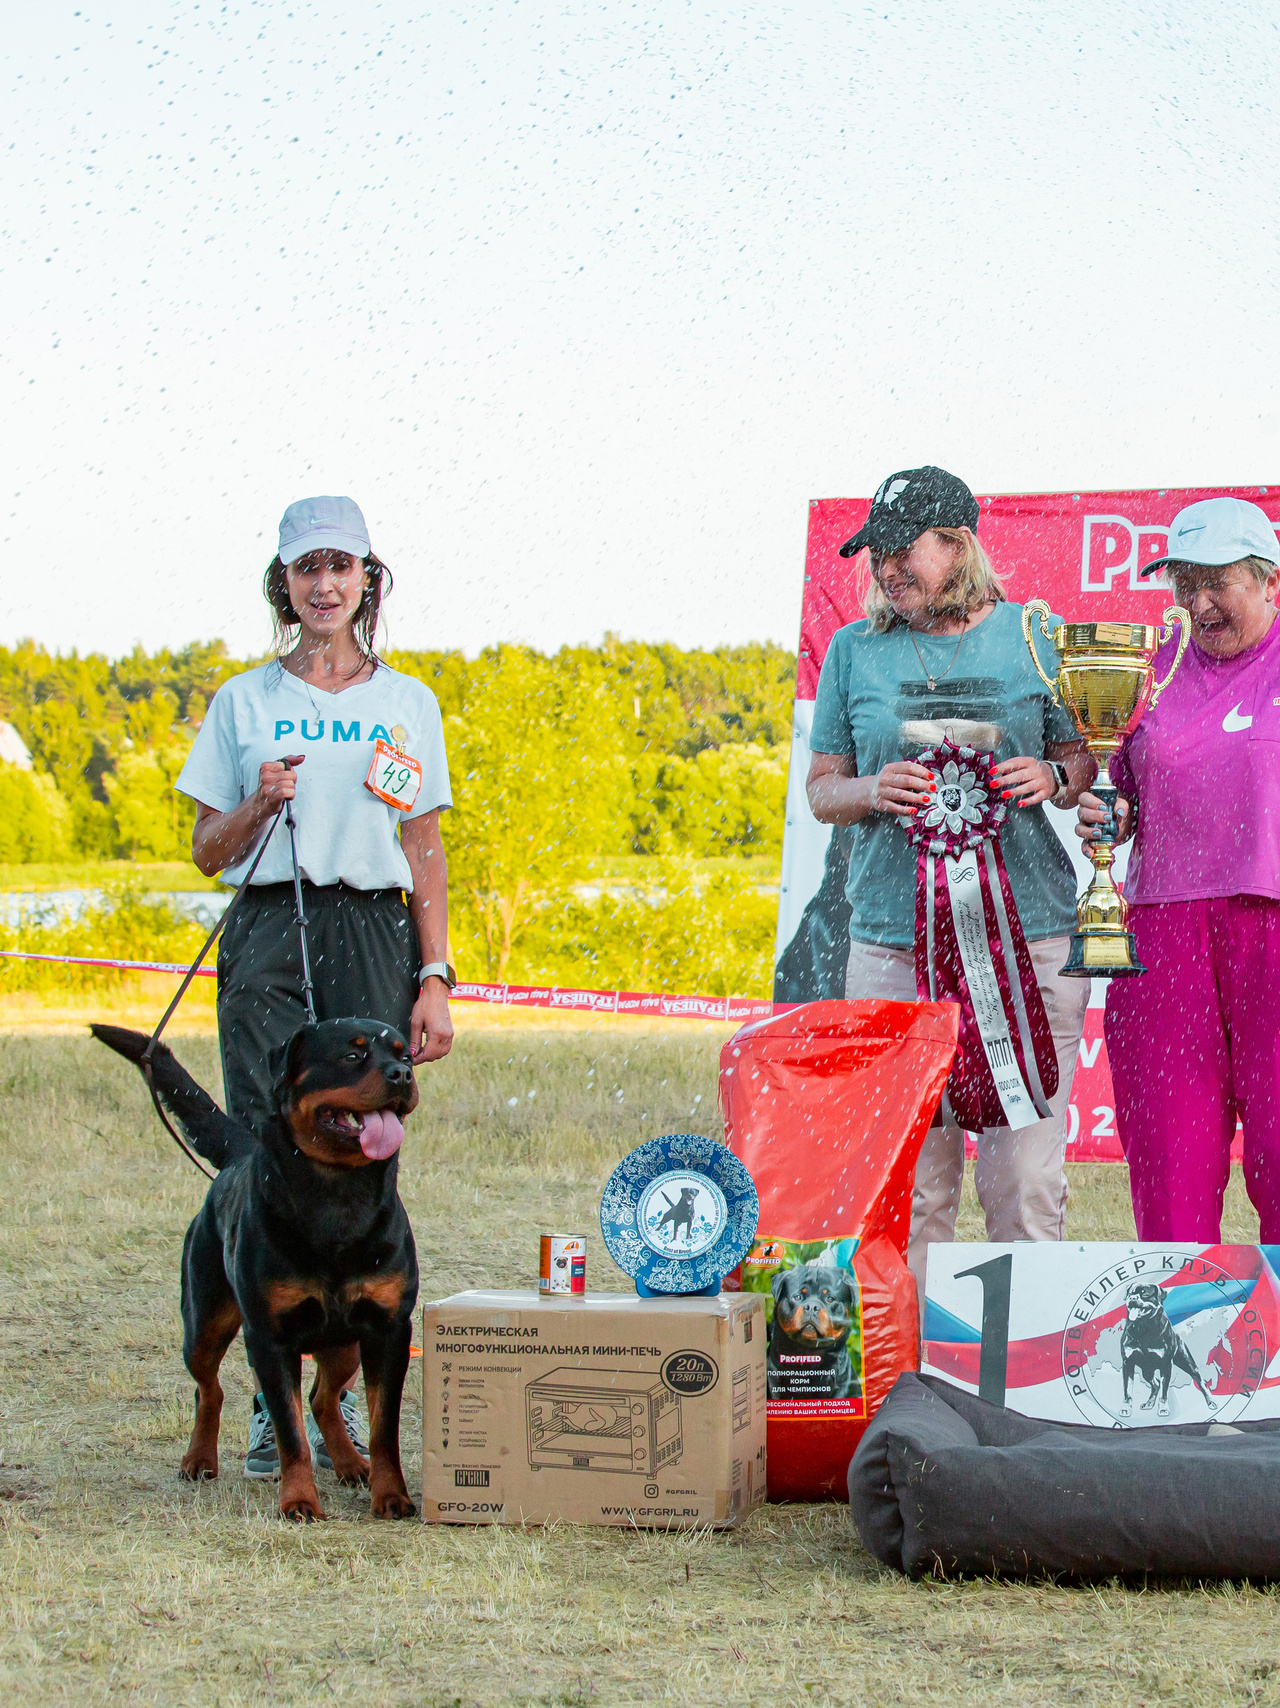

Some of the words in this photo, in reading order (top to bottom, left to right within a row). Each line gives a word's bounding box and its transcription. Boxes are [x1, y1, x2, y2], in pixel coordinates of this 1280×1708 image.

[274, 719, 393, 745] PUMA
[383, 761, 411, 794] 49
[450, 985, 503, 999] ТРАПЕЗ
[552, 993, 614, 1008] ТРАПЕЗА
[663, 1001, 725, 1016] ТРАПЕЗА
[953, 1253, 1013, 1408] 1
[1064, 1255, 1147, 1397] РОТВЕЙЛЕР
[1161, 1255, 1229, 1287] КЛУБ
[1233, 1293, 1263, 1399] РОССИИ
[435, 1343, 590, 1355] МНОГОФУНКЦИОНАЛЬНАЯ
[592, 1345, 662, 1356] МИНИ-ПЕЧЬ
[779, 1355, 821, 1364] PROFIFEED
[671, 1373, 696, 1382] 1280
[767, 1368, 836, 1377] ПОЛНОРАЦИОННЫЙ
[787, 1385, 832, 1393] ЧЕМПИОНОВ
[437, 1502, 504, 1513] GFO-20W
[601, 1506, 699, 1517] WWW.GFGRIL.RU
